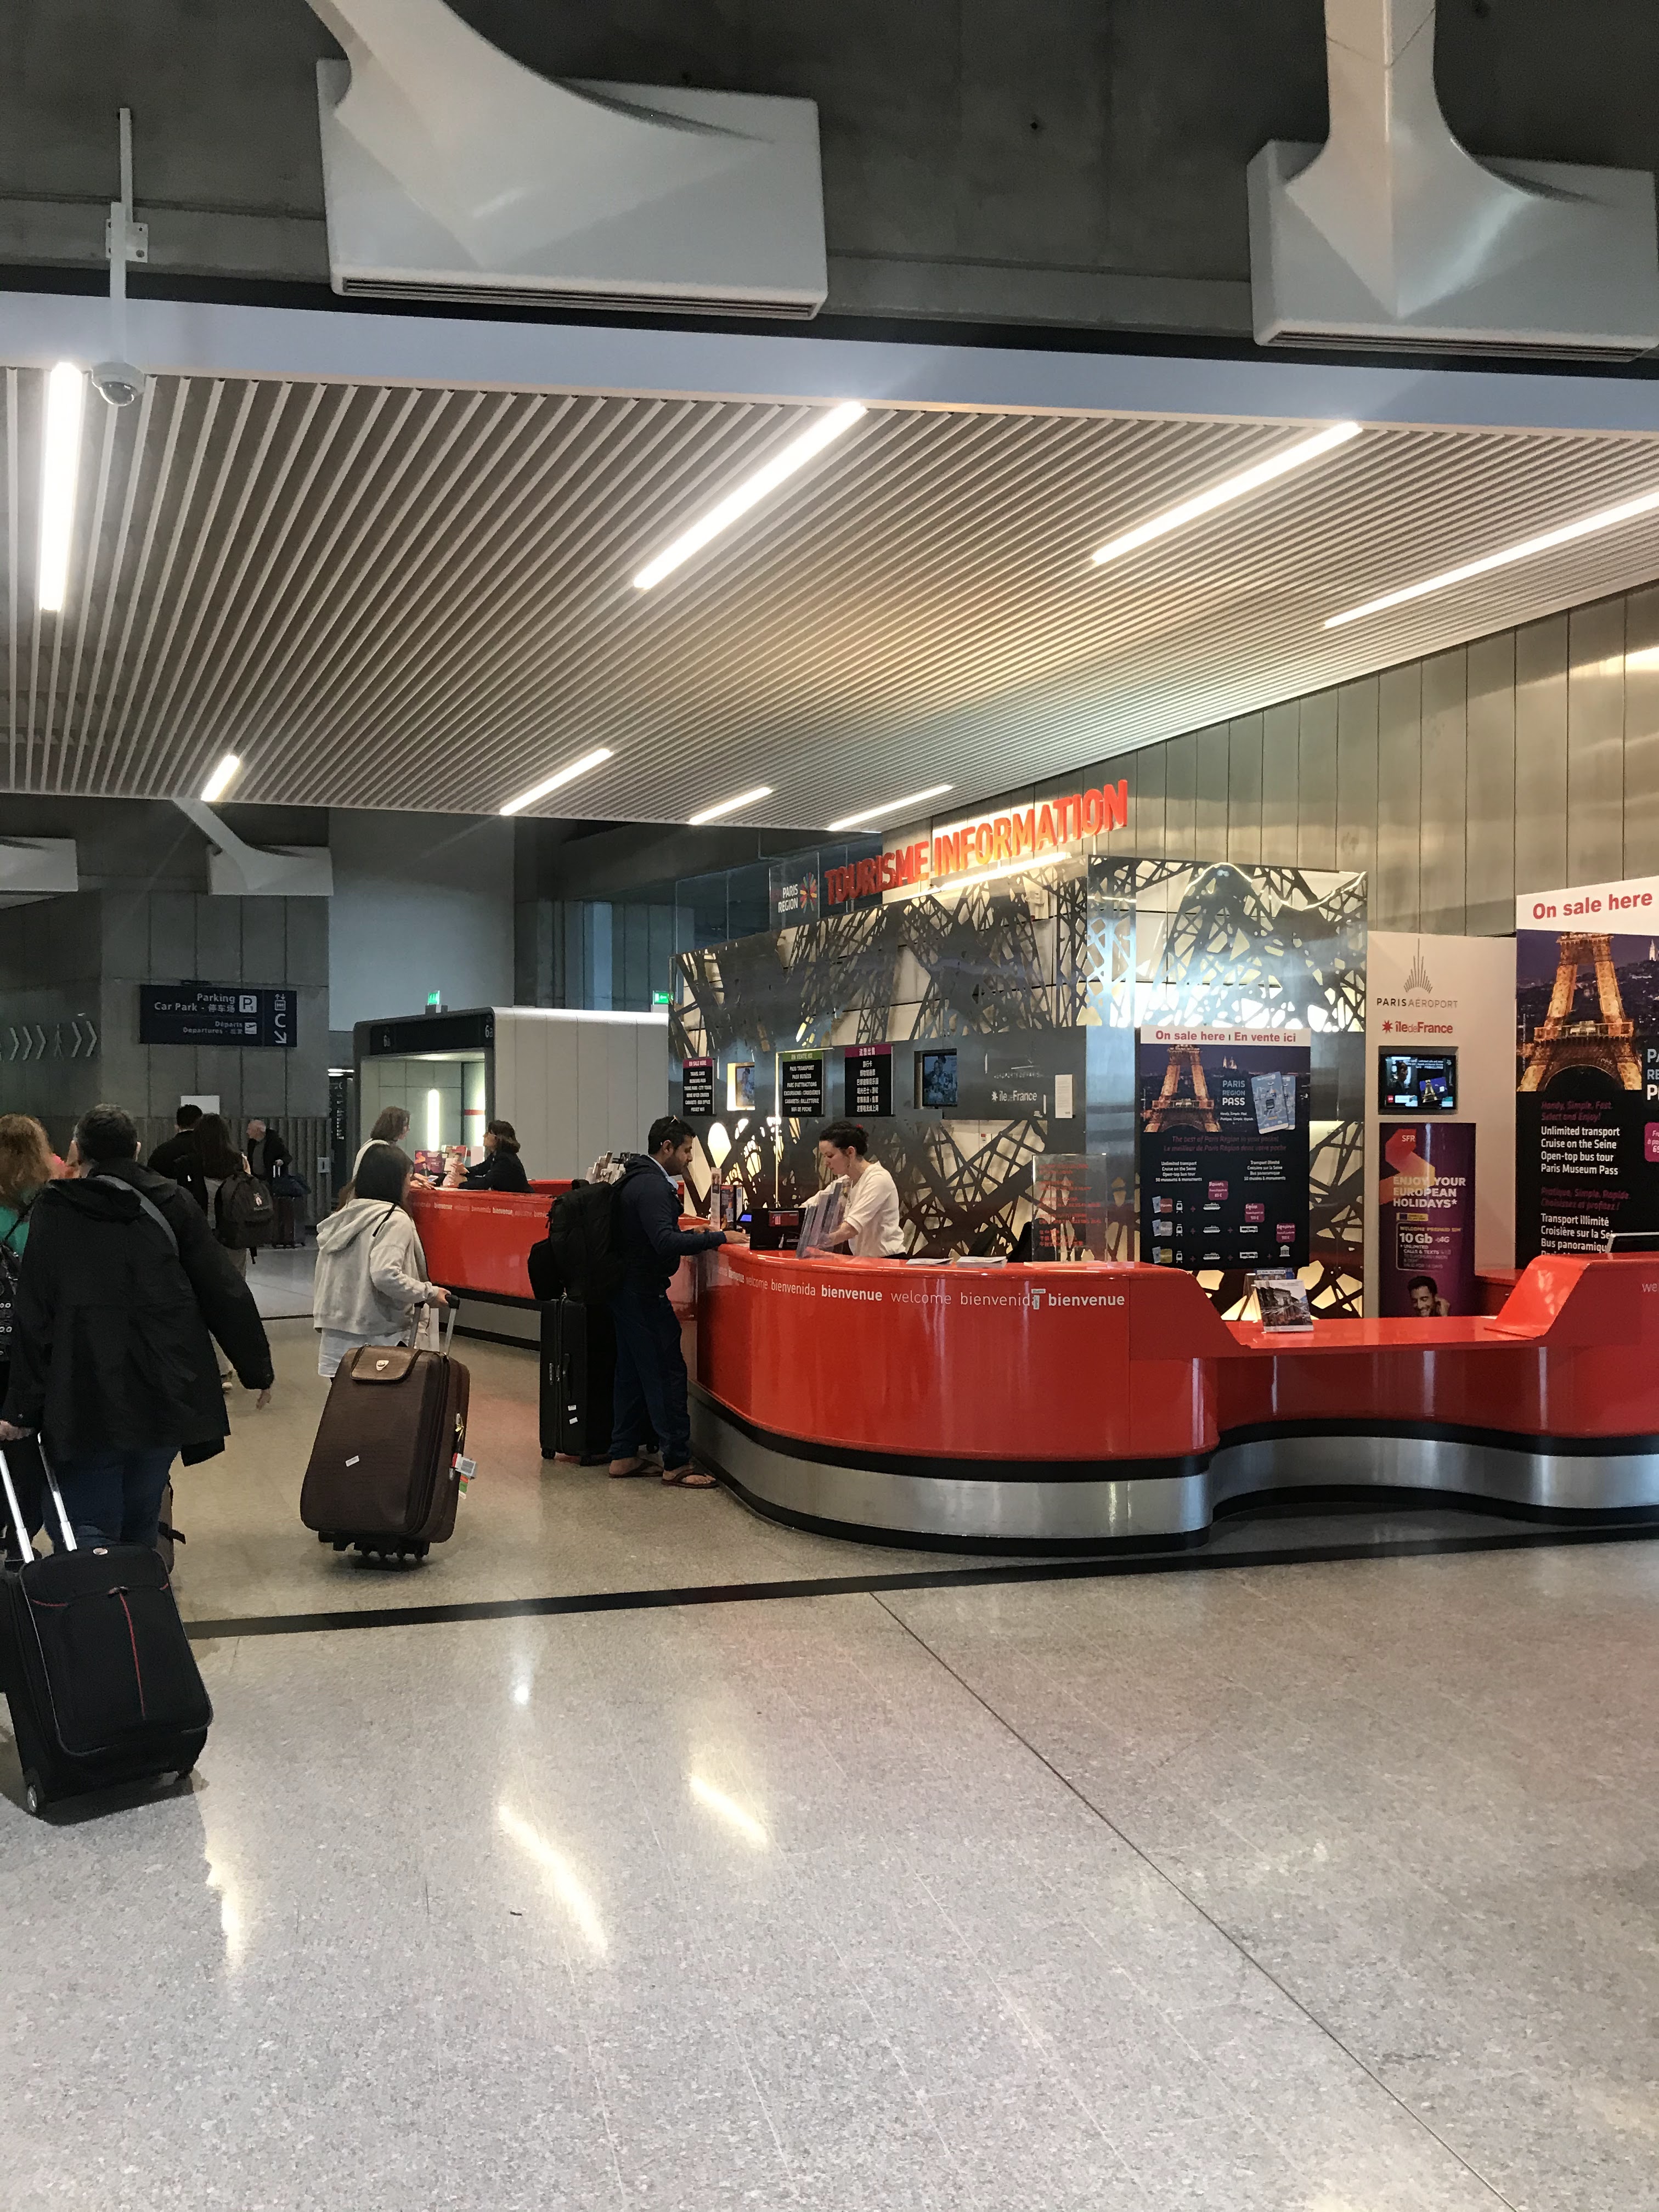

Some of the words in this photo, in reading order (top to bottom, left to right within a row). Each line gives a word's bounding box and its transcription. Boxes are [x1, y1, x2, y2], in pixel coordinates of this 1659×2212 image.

[825, 841, 929, 905] TOURISME
[934, 780, 1128, 877] INFORMATION
[782, 884, 798, 898] PARIS
[778, 897, 798, 913] REGION
[1533, 903, 1556, 919] On
[1563, 897, 1601, 916] sale
[1609, 893, 1652, 910] here
[197, 993, 235, 1004] Parking
[154, 1002, 172, 1011] Car
[175, 1003, 197, 1011] Park
[275, 1013, 286, 1028] C
[1155, 1030, 1171, 1040] On
[1174, 1031, 1197, 1041] sale
[1201, 1031, 1225, 1041] here
[1234, 1032, 1248, 1041] En
[1251, 1033, 1280, 1042] vente
[1284, 1033, 1296, 1042] ici
[1222, 1097, 1245, 1106] PASS
[1541, 1126, 1580, 1136] Unlimited
[1582, 1127, 1620, 1138] transport
[1541, 1138, 1565, 1148] Cruise
[1579, 1139, 1592, 1148] the
[1594, 1139, 1617, 1149] Seine
[1541, 1151, 1578, 1163] Open-top
[1580, 1152, 1594, 1161] bus
[1596, 1153, 1614, 1162] tour
[1541, 1163, 1560, 1173] Paris
[1562, 1164, 1597, 1173] Museum
[1599, 1165, 1618, 1175] Pass
[1393, 1176, 1430, 1186] ENJOY
[1434, 1177, 1466, 1186] YOUR
[1393, 1187, 1457, 1197] EUROPEAN
[1541, 1213, 1578, 1226] Transport
[1541, 1226, 1575, 1237] Croisière
[1592, 1229, 1599, 1238] la
[1399, 1233, 1413, 1243] 10
[1415, 1233, 1433, 1244] Gb
[1541, 1238, 1556, 1248] Bus
[771, 1279, 816, 1296] bienvenida
[822, 1285, 883, 1301] bienvenue
[890, 1290, 952, 1305] welcome
[1048, 1293, 1125, 1306] bienvenue
